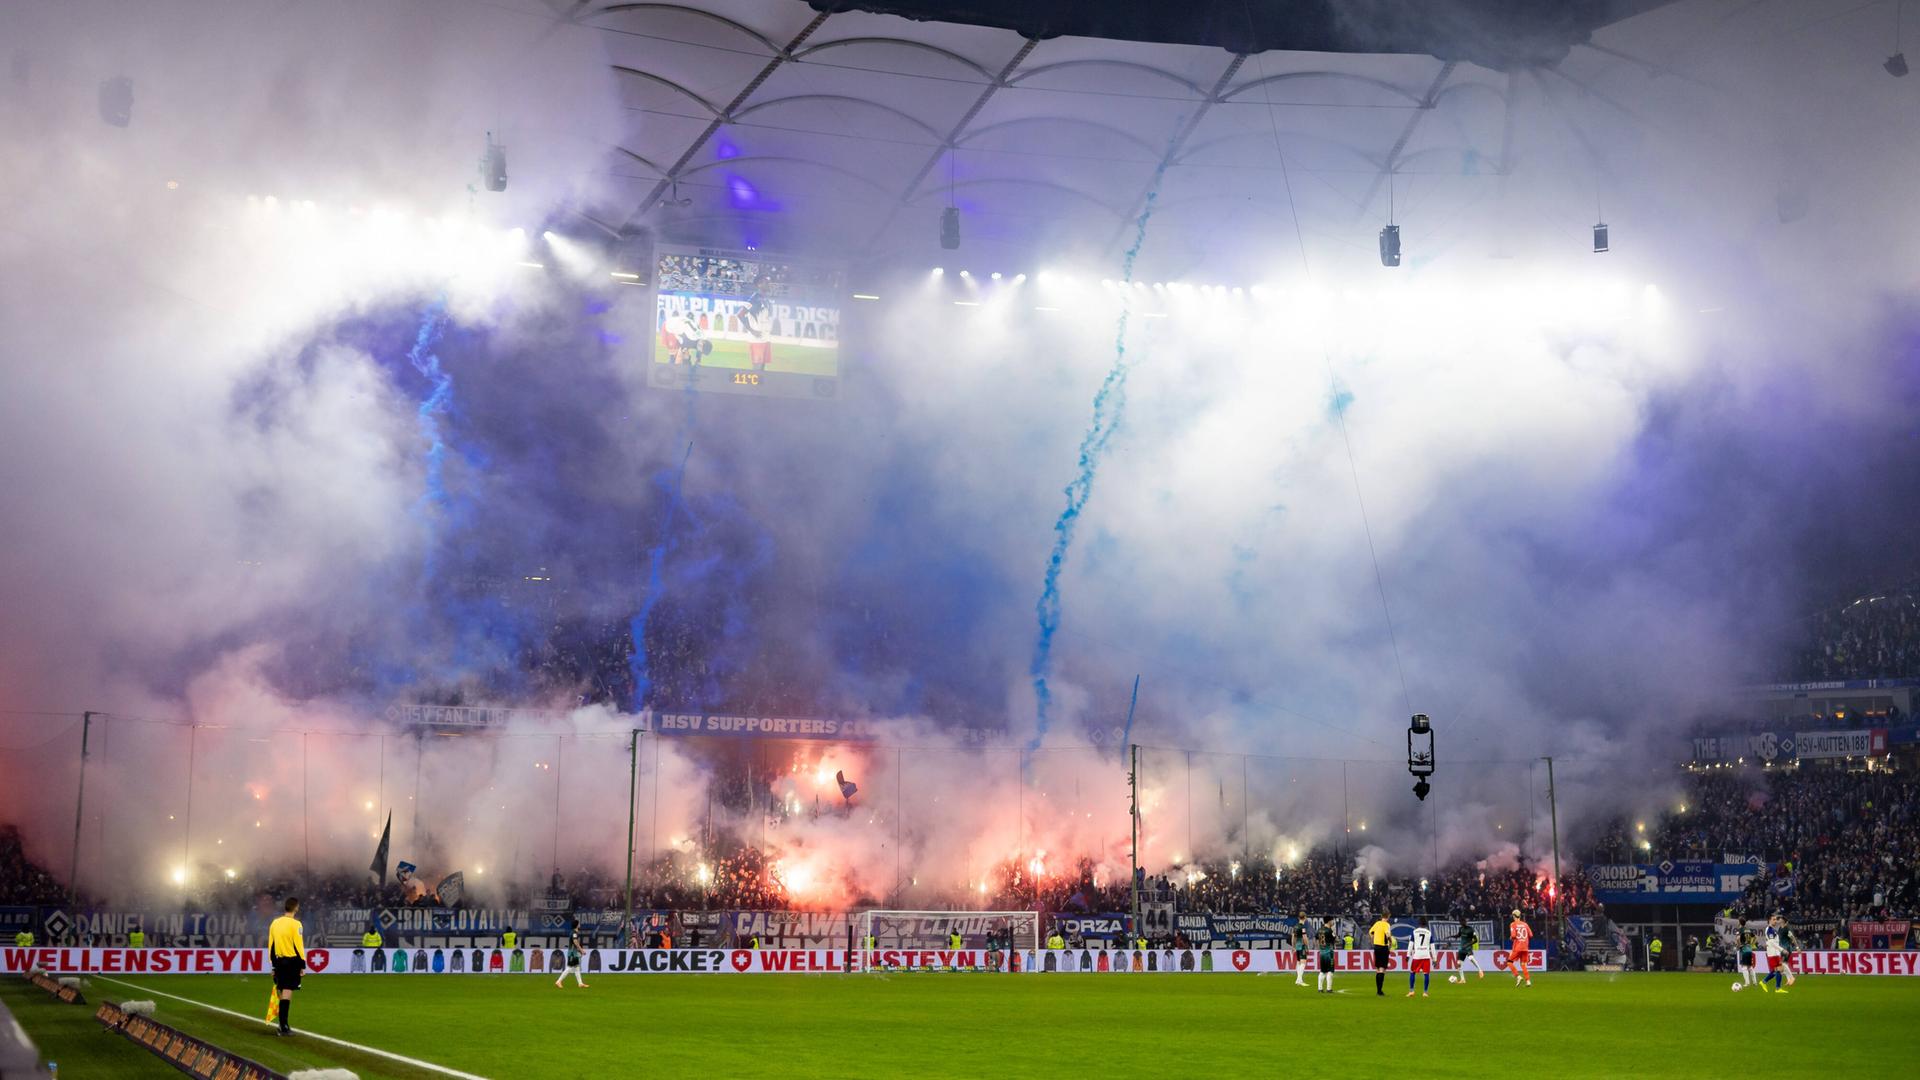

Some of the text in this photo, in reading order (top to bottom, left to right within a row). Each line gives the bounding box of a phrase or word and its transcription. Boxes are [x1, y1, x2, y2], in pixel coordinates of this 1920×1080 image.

[734, 374, 759, 385] 11°C
[402, 706, 430, 722] HSV
[436, 707, 463, 723] FAN
[468, 708, 504, 725] CLUB
[662, 714, 703, 730] HSV
[707, 716, 838, 735] SUPPORTERS
[1797, 735, 1850, 753] HSV-KUTTEN
[1852, 735, 1869, 751] 1887
[1723, 852, 1746, 865] NORD
[1600, 865, 1638, 880] NORD
[1600, 880, 1638, 889] SACHSEN
[154, 913, 185, 936] ON
[397, 908, 516, 930] IRON LOYALTY
[1061, 919, 1123, 933] ORZA
[1178, 915, 1207, 927] BANDA
[1212, 917, 1294, 935] Volksparkstadion
[1852, 922, 1906, 932] HSV FAN CLUB
[1418, 933, 1426, 946] 7
[1515, 926, 1528, 940] 30
[5, 949, 263, 971] WELLENSTEYN
[608, 950, 726, 971] JACKE?
[760, 950, 976, 971] WELLENSTEYN
